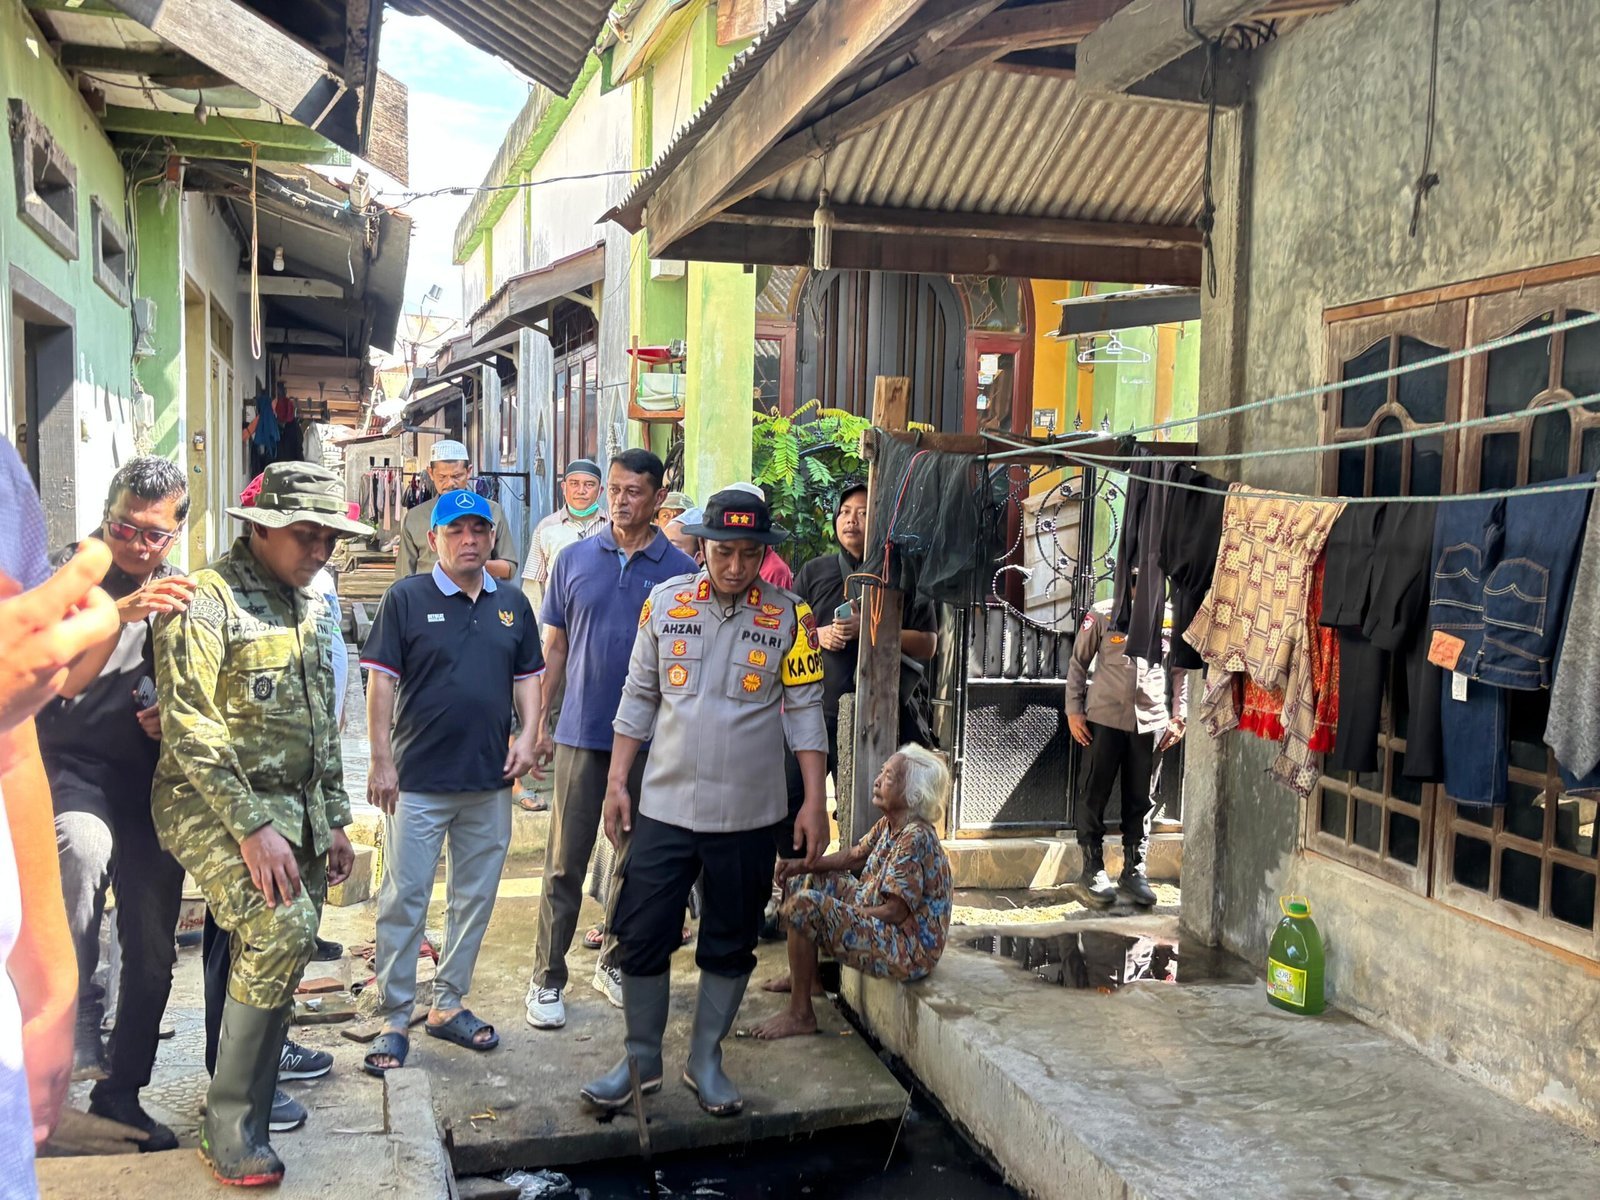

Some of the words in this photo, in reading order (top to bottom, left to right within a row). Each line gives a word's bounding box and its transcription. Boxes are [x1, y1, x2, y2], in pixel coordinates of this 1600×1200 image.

[662, 623, 702, 635] AHZAN
[742, 630, 782, 648] POLRI
[787, 656, 806, 678] KA
